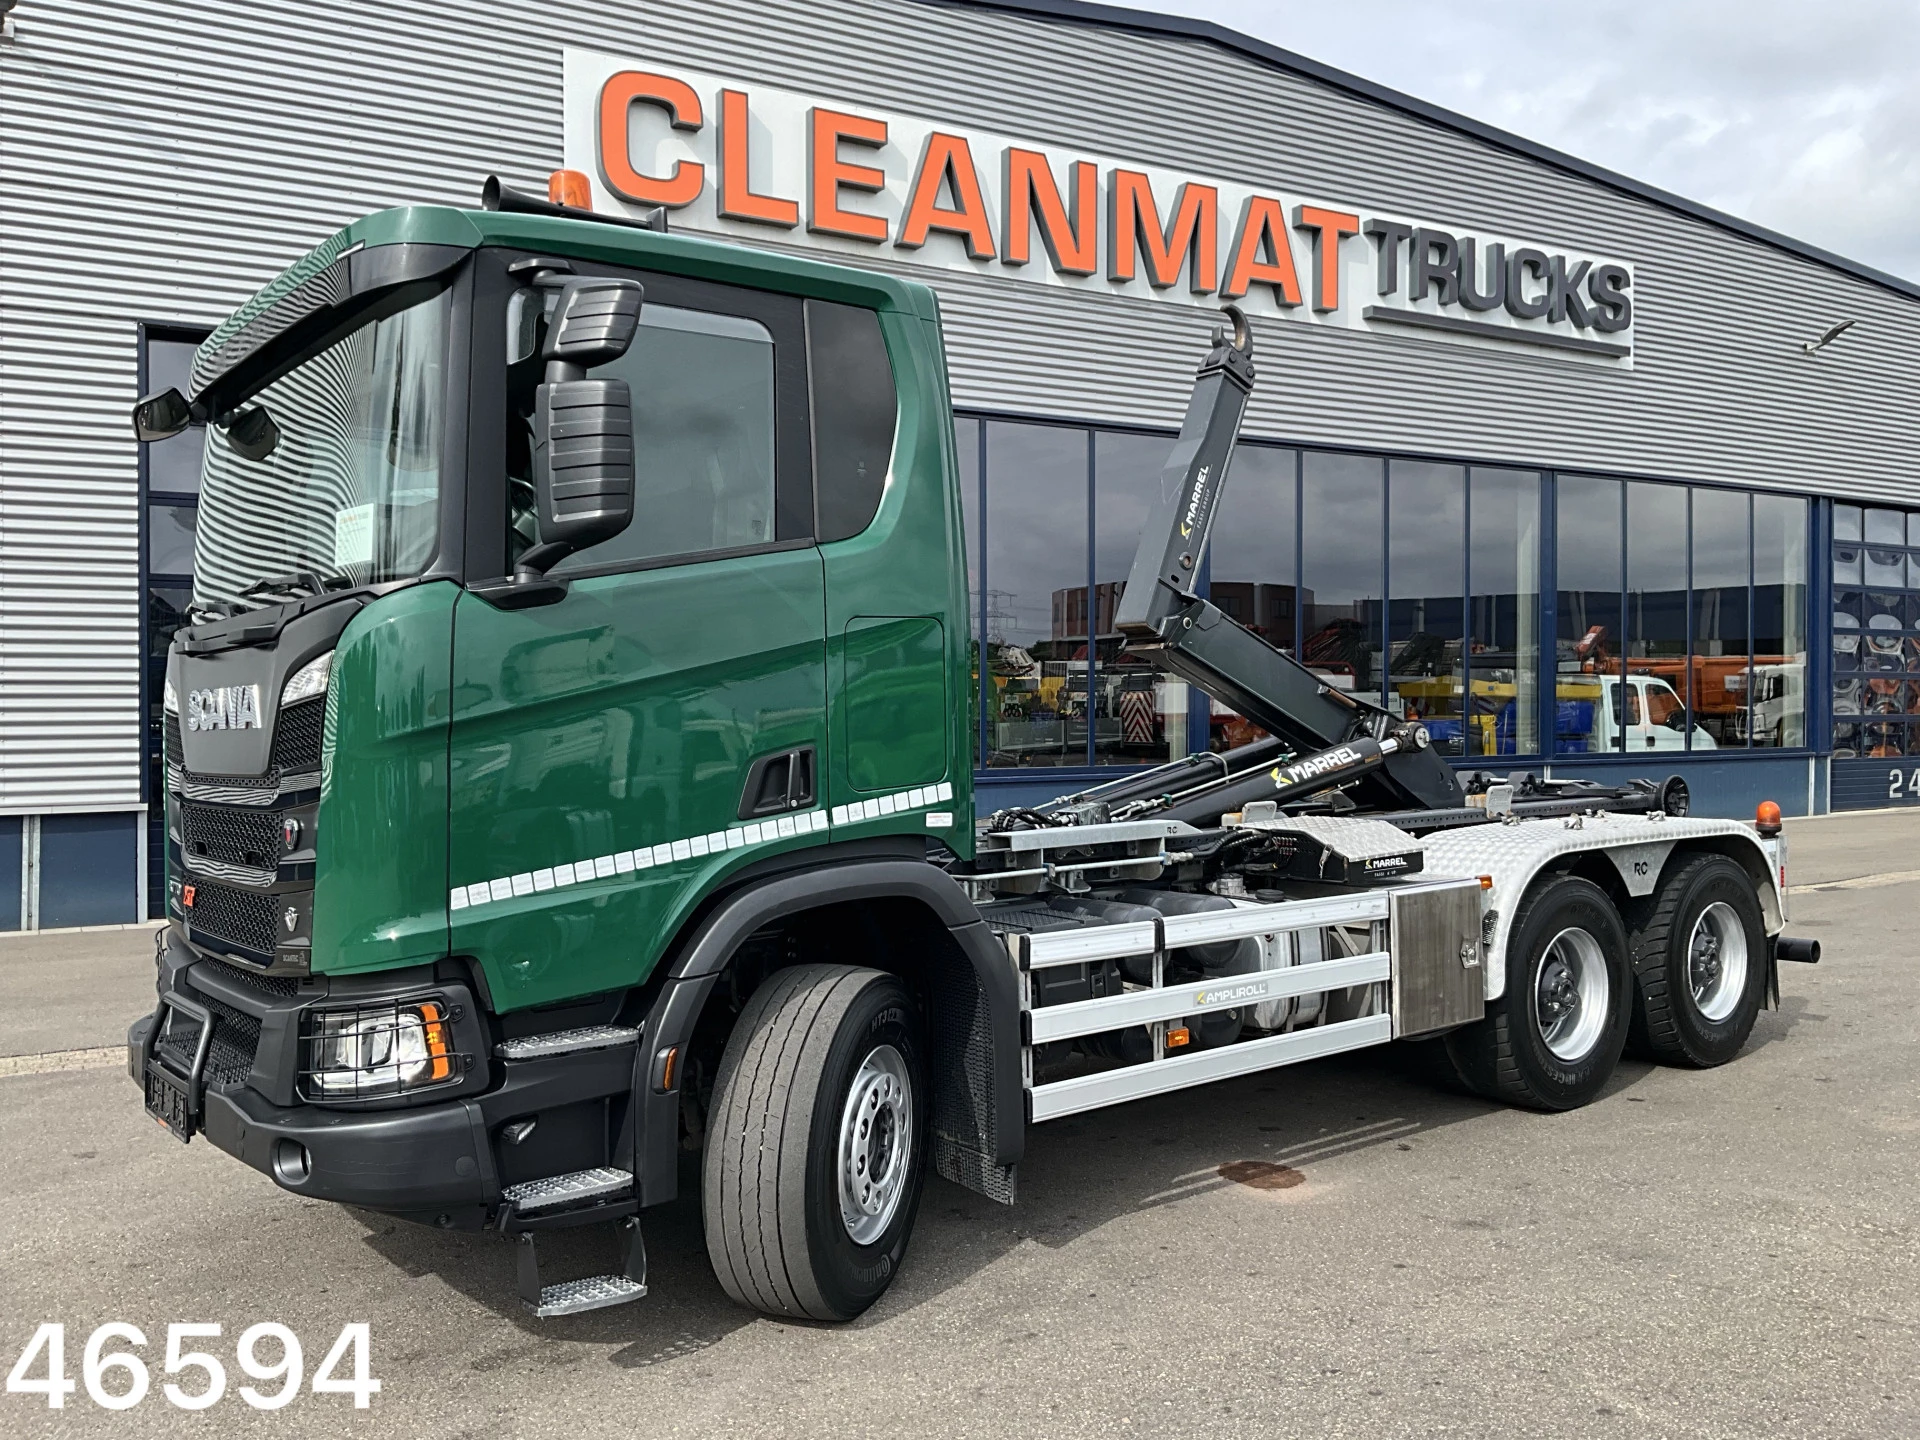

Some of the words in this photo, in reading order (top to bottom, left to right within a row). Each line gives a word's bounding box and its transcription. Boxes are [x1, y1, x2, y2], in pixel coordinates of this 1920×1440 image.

[595, 70, 1359, 314] CLEANMAT
[1363, 218, 1631, 333] TRUCKS
[1185, 465, 1209, 526] MARREL
[1203, 488, 1211, 509] GROUP
[188, 683, 262, 732] SCANIA
[1288, 747, 1362, 783] MARREL
[1166, 826, 1178, 834] RC
[1372, 857, 1408, 868] MARREL
[1634, 861, 1648, 876] RC
